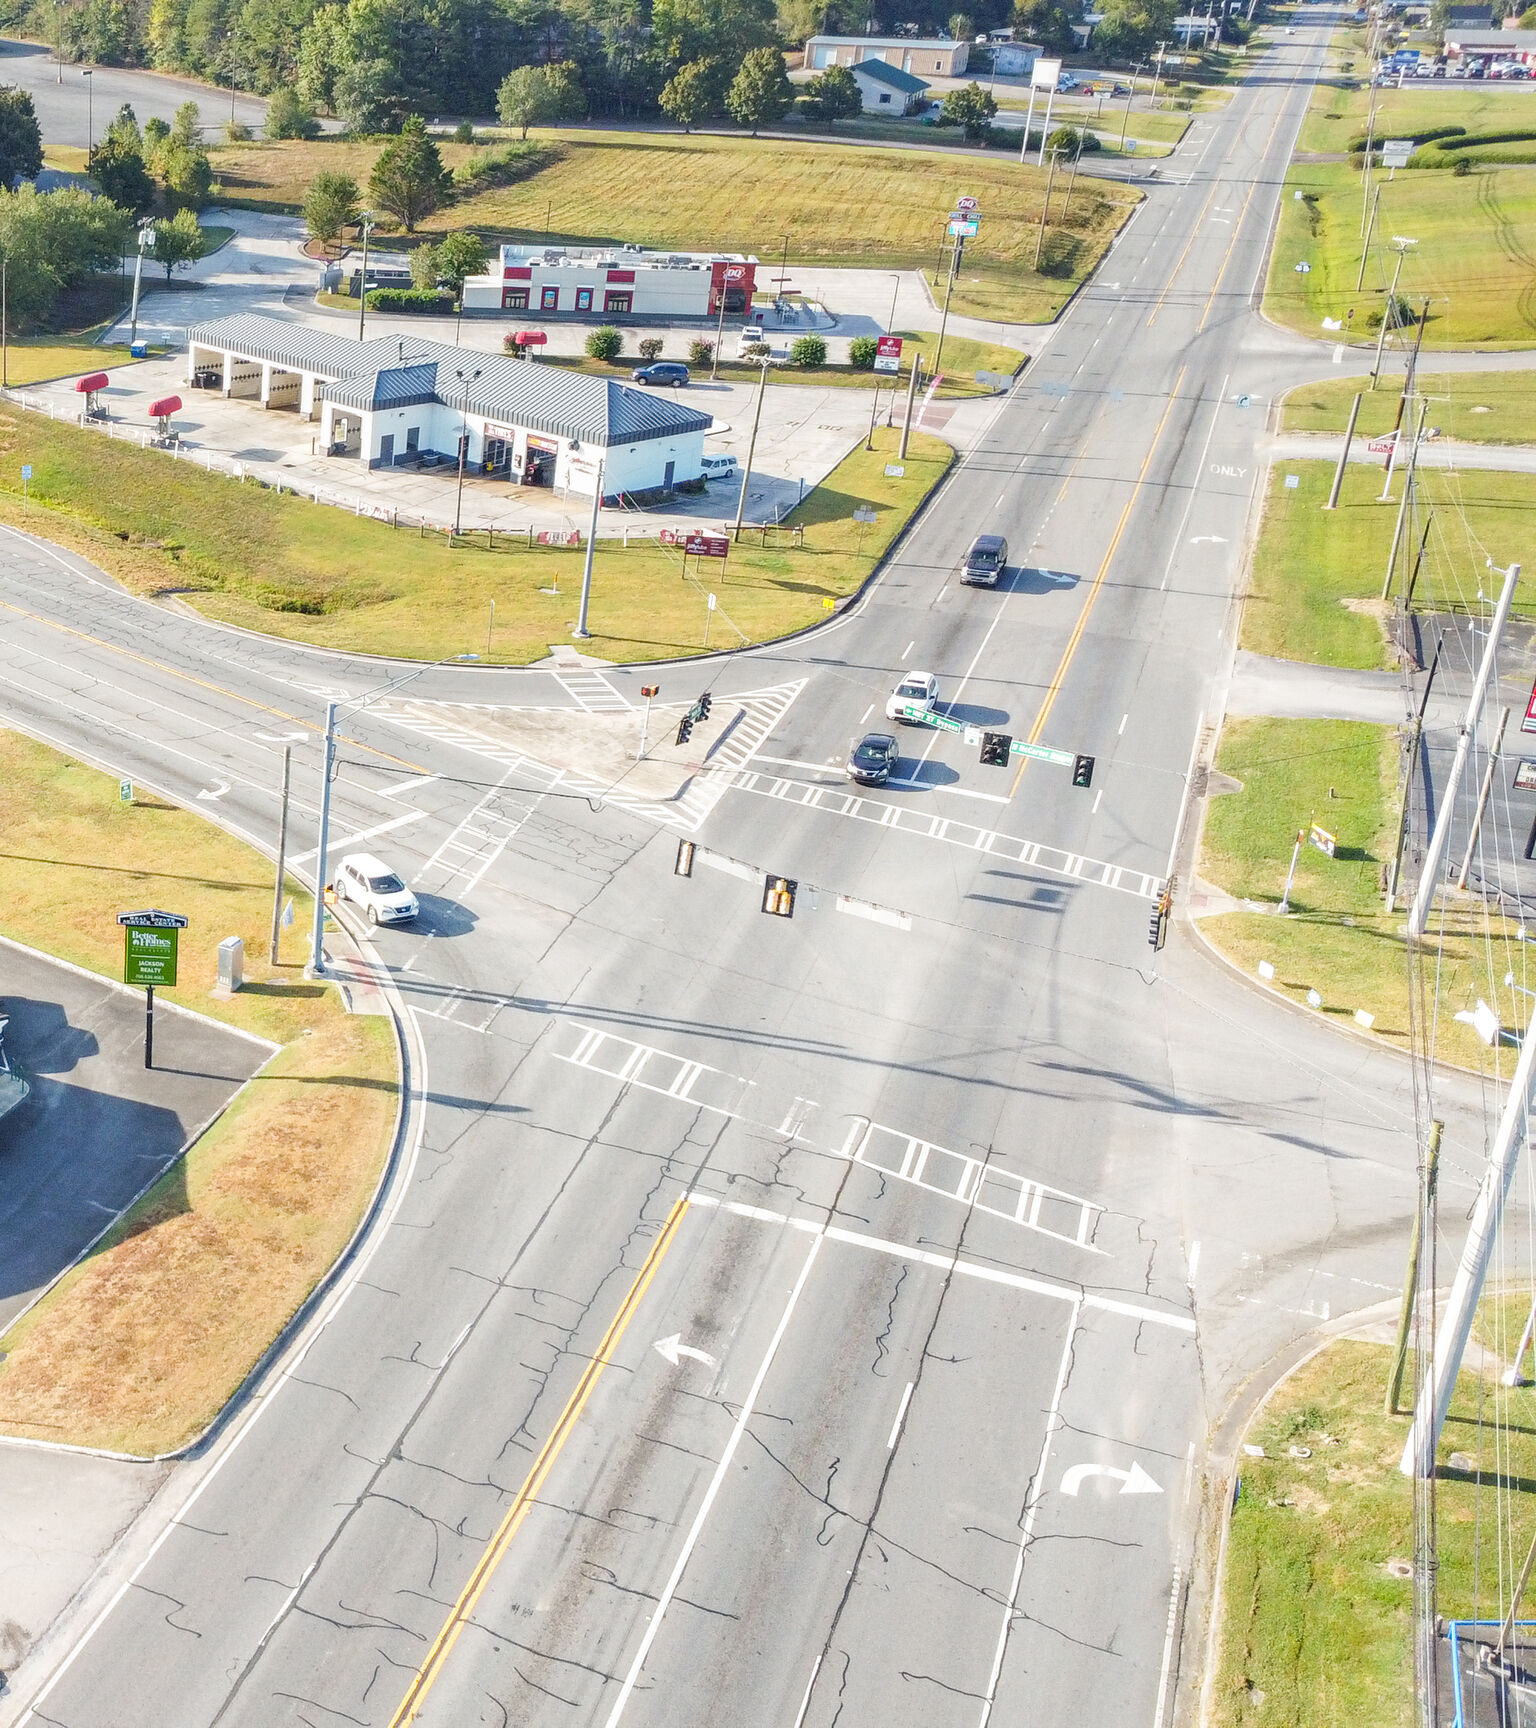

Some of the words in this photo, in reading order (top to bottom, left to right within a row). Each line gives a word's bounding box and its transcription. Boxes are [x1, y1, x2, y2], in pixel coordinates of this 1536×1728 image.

[728, 269, 742, 278] DQ
[1210, 464, 1247, 478] ONLY
[132, 930, 158, 939] Better
[139, 937, 171, 946] Homes
